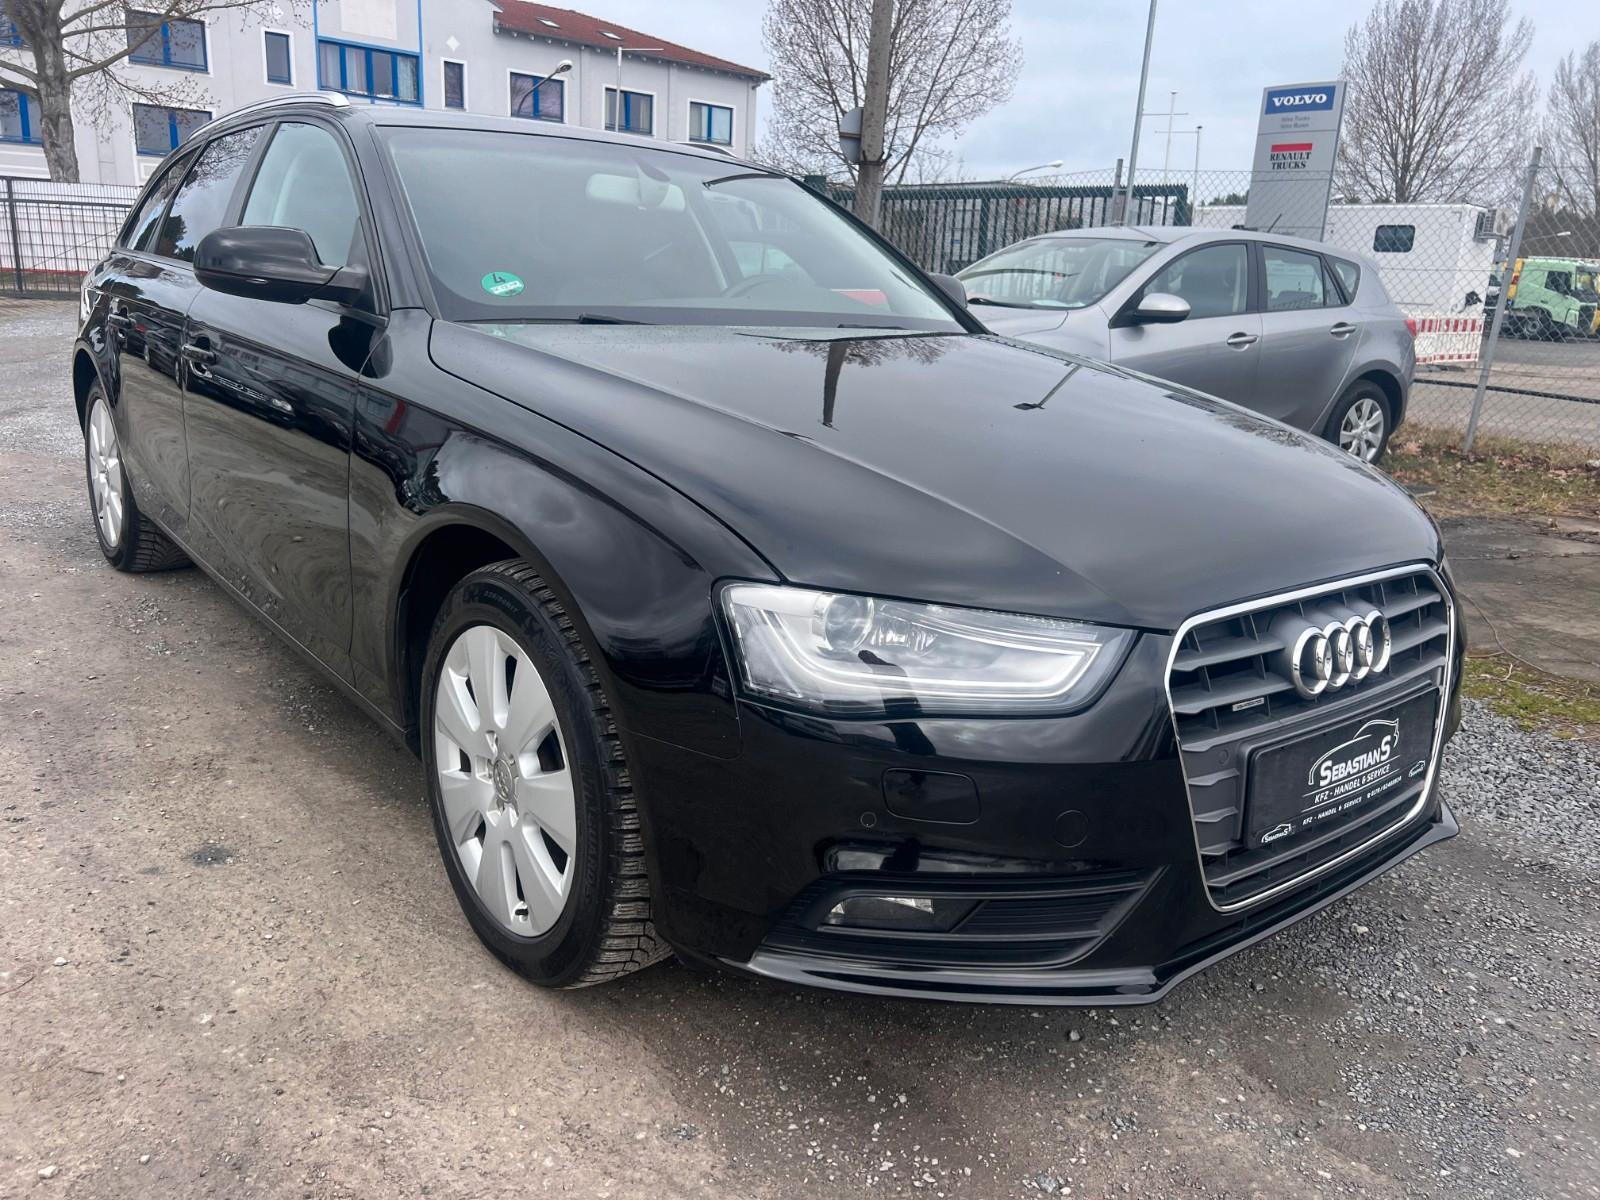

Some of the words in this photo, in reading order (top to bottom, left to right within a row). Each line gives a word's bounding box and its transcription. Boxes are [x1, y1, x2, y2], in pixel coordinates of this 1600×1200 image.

[1272, 94, 1327, 106] VOLVO
[1269, 152, 1311, 161] RENAULT
[1271, 161, 1306, 170] TRUCKS
[492, 273, 506, 284] 4
[1314, 790, 1330, 804] KFZ
[1333, 778, 1361, 797] HANDEL
[1366, 763, 1391, 783] SERVICE
